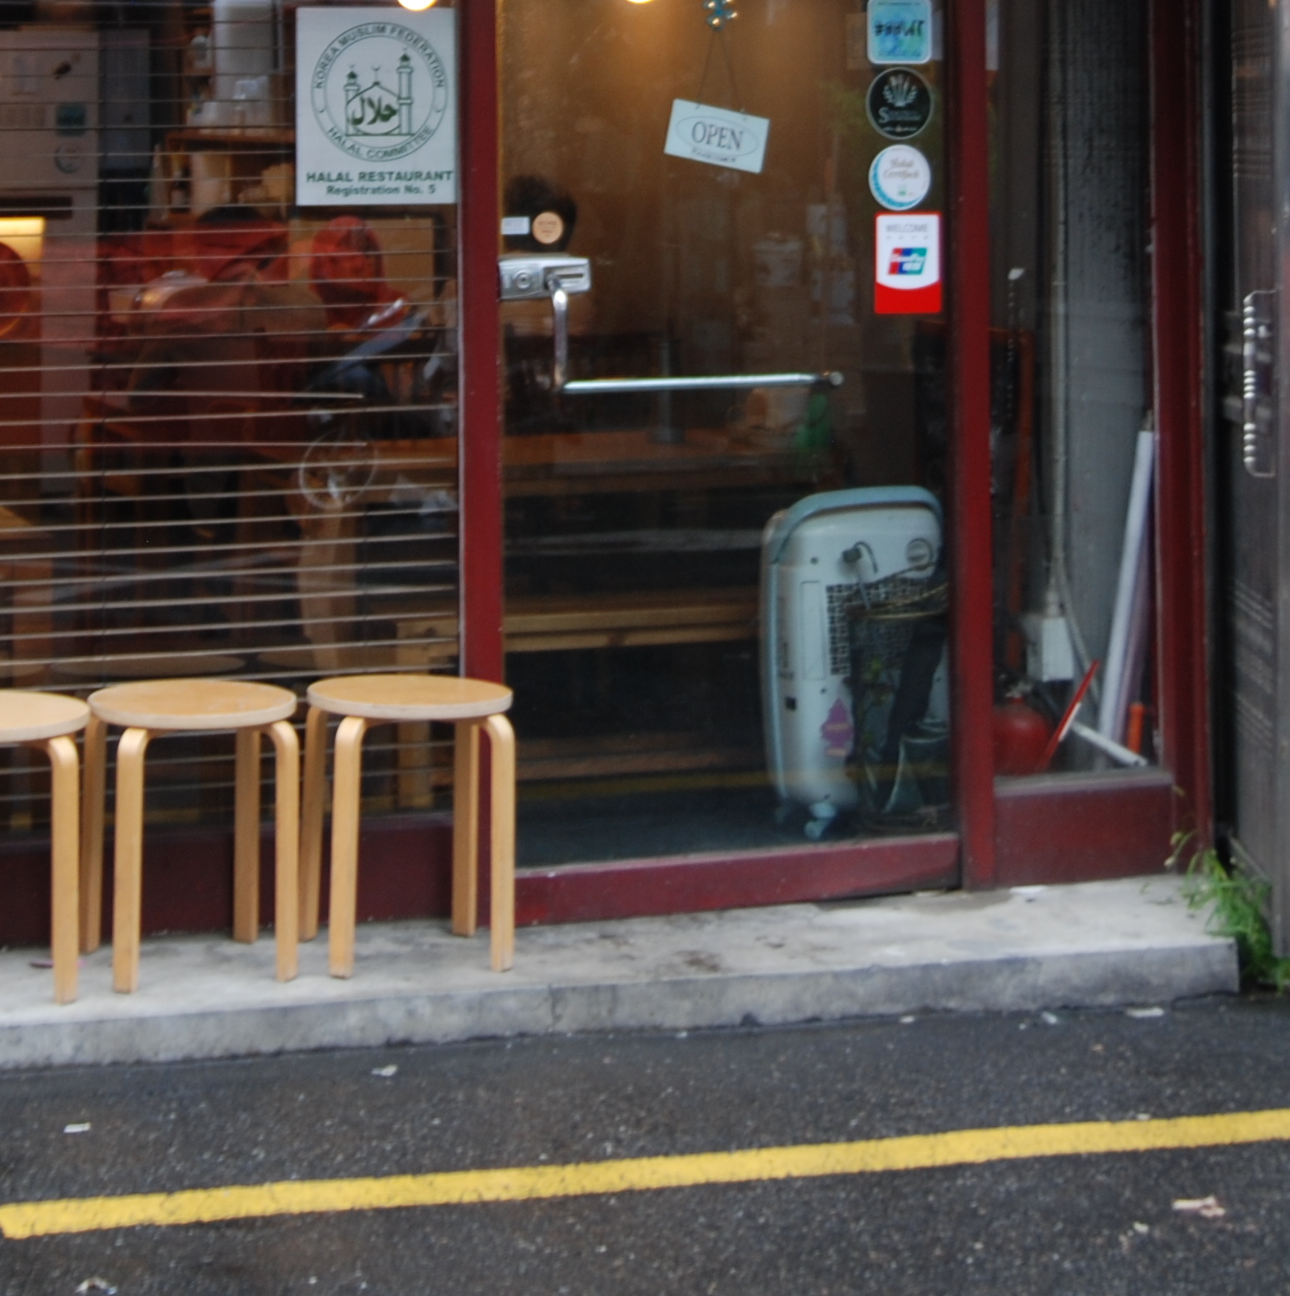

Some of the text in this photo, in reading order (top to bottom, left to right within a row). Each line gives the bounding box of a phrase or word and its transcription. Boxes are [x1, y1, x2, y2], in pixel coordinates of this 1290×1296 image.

[315, 25, 445, 89] KOREA MUSLIM FEDERATION
[351, 95, 398, 126] حلال
[327, 125, 433, 160] HALAL COMMITTEE
[691, 120, 744, 152] OPEN
[306, 170, 454, 183] HALAL RESTAURANT
[326, 185, 401, 197] Registration
[403, 185, 424, 195] No.
[885, 223, 929, 234] WELCOME
